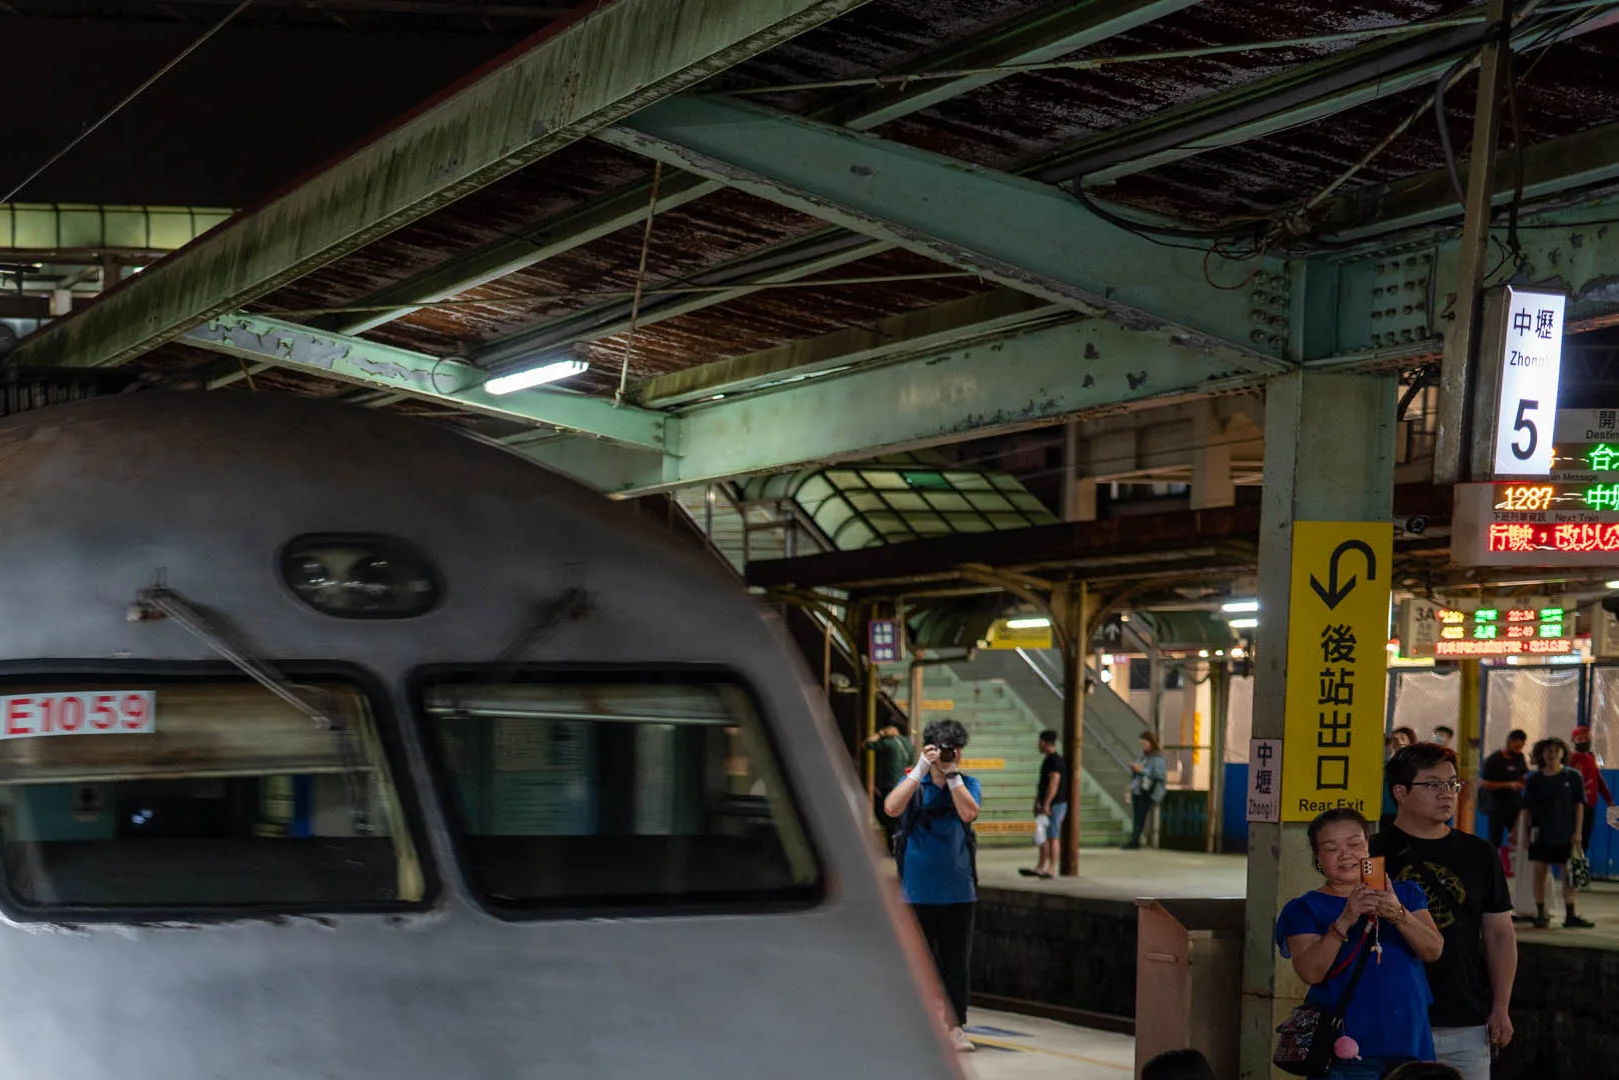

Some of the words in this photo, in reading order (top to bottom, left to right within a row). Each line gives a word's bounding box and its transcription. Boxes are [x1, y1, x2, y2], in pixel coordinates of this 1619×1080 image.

[1513, 308, 1554, 339] 中壢
[1511, 398, 1539, 461] 5
[1504, 486, 1553, 511] 1287
[1555, 512, 1576, 523] Next
[1579, 512, 1600, 522] Train
[5, 694, 149, 735] E1059
[1317, 624, 1357, 790] 後站出口
[1255, 741, 1273, 795] 中壢
[1248, 798, 1278, 819] Zhongli
[1298, 797, 1333, 812] Rear
[1336, 797, 1364, 812] Exit
